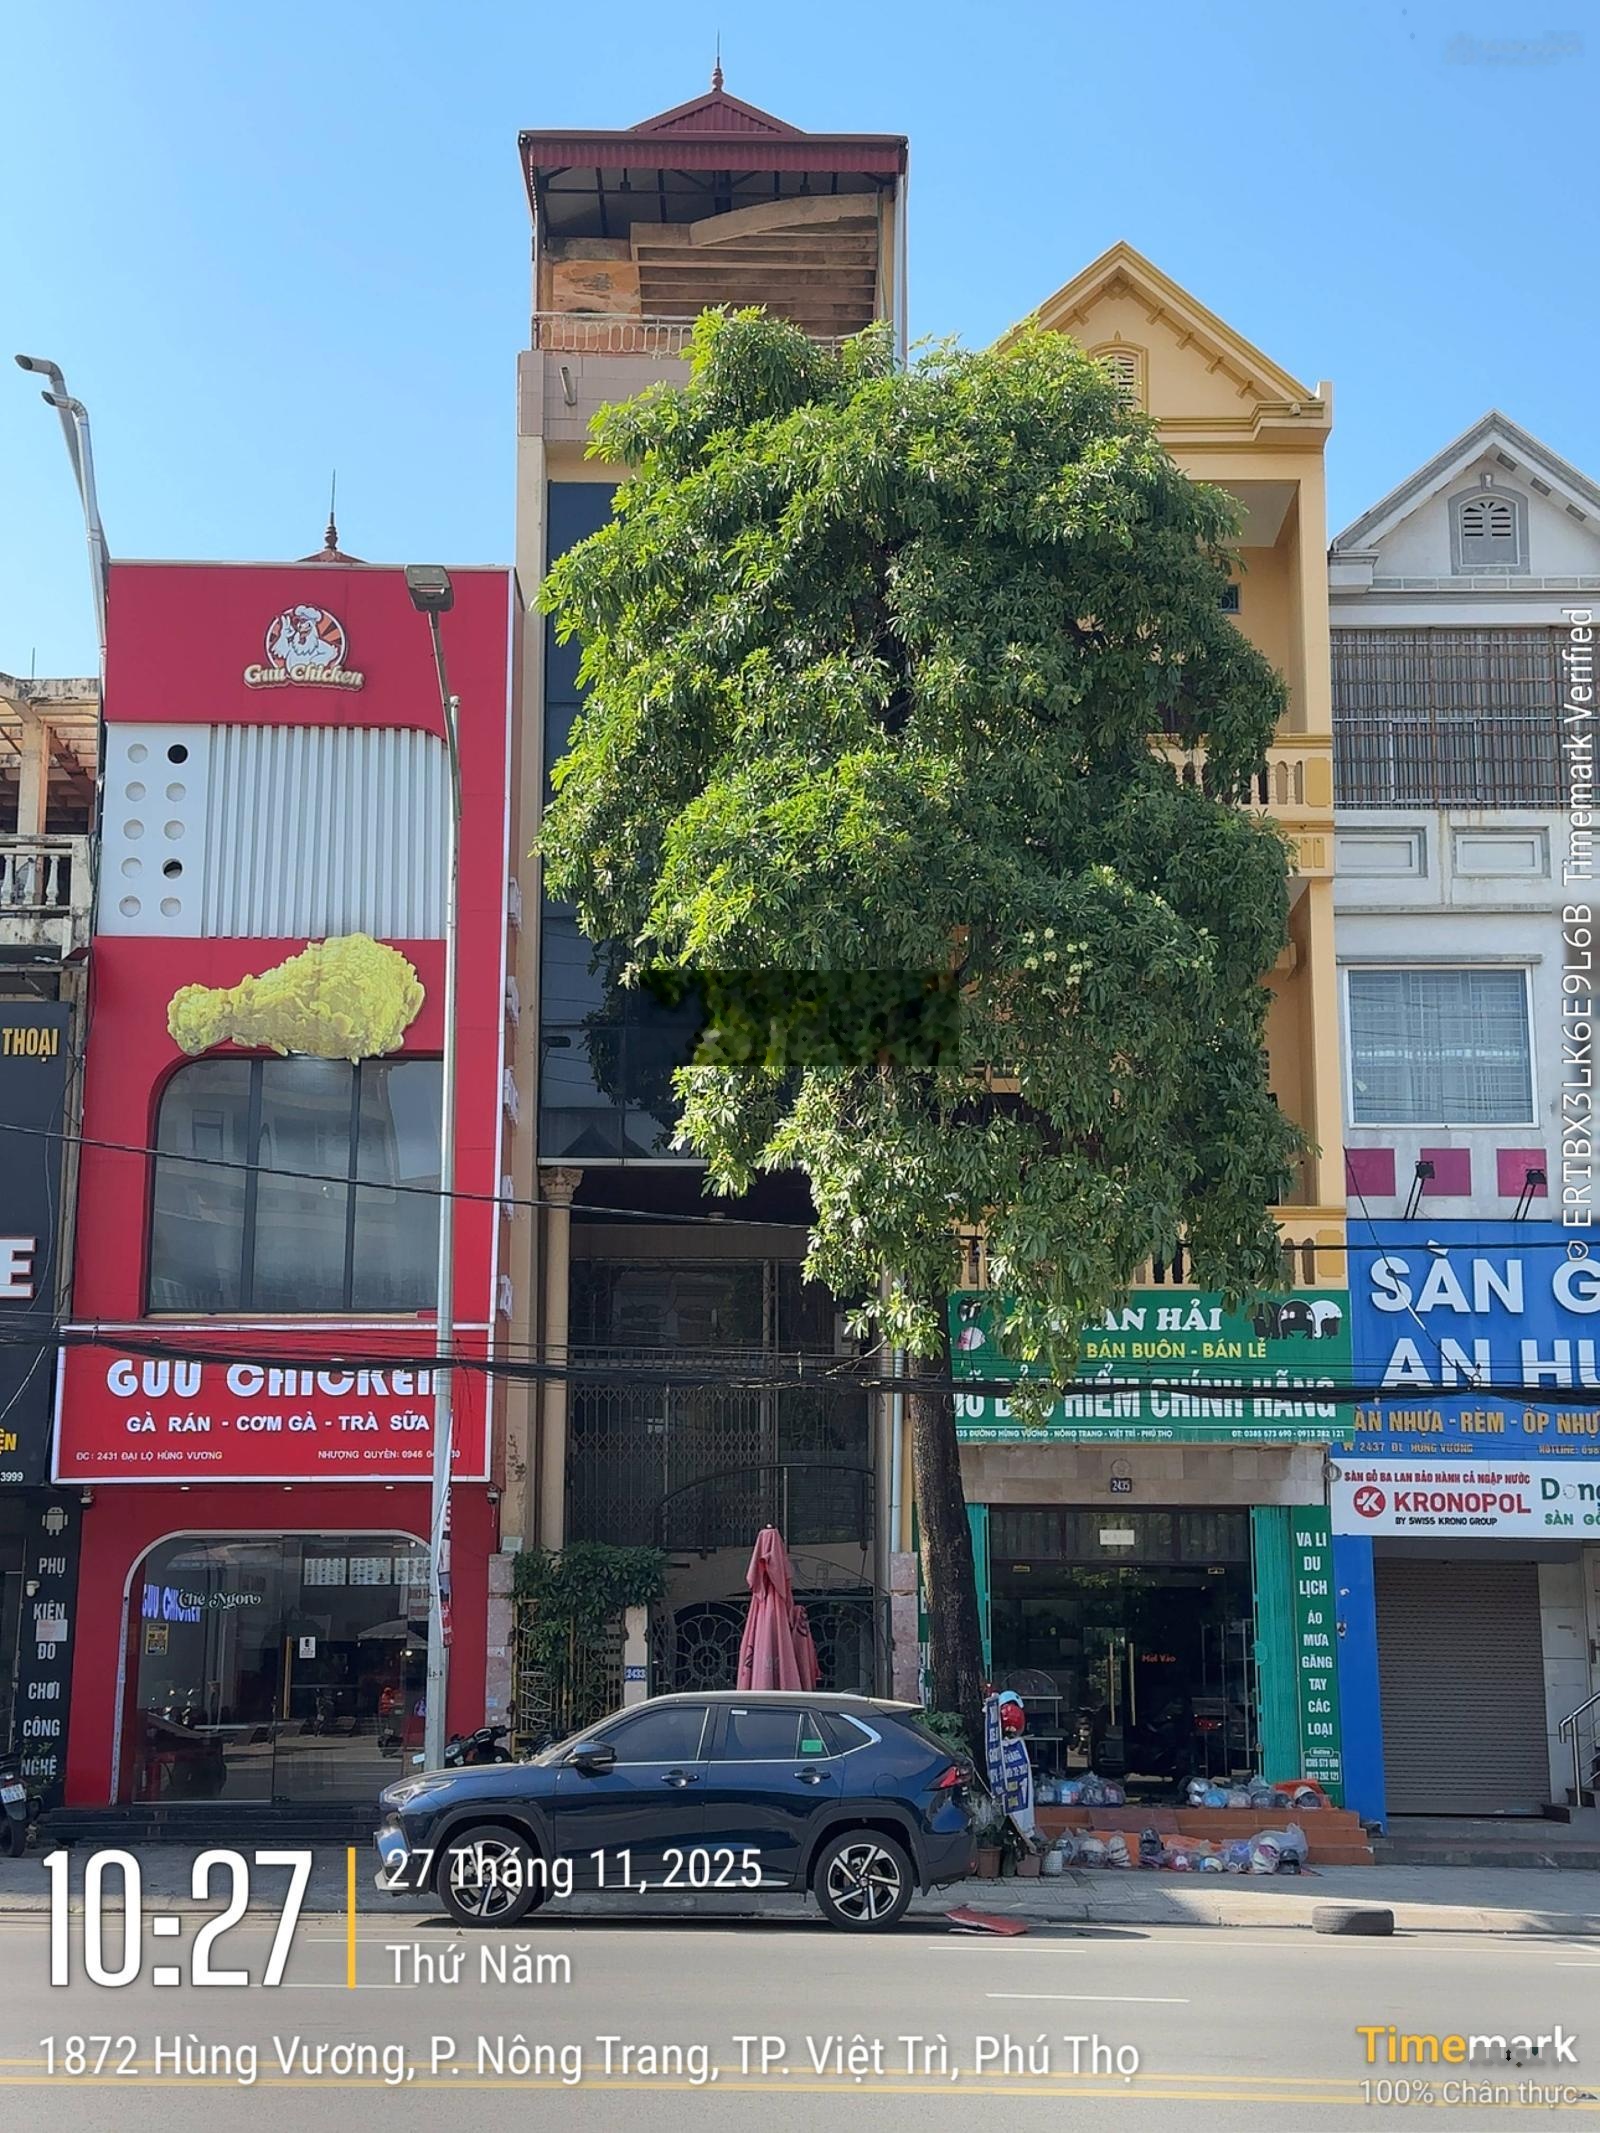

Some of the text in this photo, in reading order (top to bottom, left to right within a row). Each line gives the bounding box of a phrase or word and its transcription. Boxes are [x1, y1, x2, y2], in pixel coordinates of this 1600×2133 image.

[244, 663, 364, 689] Guu Chicken
[2, 1028, 59, 1062] THOẠI
[1370, 1239, 1524, 1313] SÀN
[1156, 1298, 1223, 1332] HẢI
[1087, 1338, 1126, 1358] BÁN
[1132, 1338, 1186, 1358] BUÔN
[1202, 1338, 1242, 1358] BÁN
[1248, 1337, 1267, 1358] LẺ
[1380, 1337, 1493, 1388] AN
[107, 1359, 201, 1398] GUU
[1150, 1368, 1244, 1418] CHÍNH
[1252, 1368, 1337, 1418] HÃNG
[126, 1411, 156, 1432] GÀ
[168, 1413, 211, 1432] RÁN
[237, 1415, 282, 1431] CƠM
[288, 1411, 317, 1431] GÀ
[339, 1411, 379, 1431] TRÀ
[390, 1409, 430, 1431] SỮA
[1355, 1406, 1382, 1432] ÀN
[1389, 1408, 1444, 1437] NHỰA
[1460, 1406, 1505, 1433] RÈM
[1522, 1403, 1550, 1433] ỐP
[1360, 1442, 1384, 1452] 2437
[97, 1452, 117, 1460] 2431
[121, 1452, 137, 1463] ĐẠI
[1345, 1470, 1364, 1482] SÀN
[1380, 1472, 1392, 1482] BA
[1394, 1472, 1412, 1482] LAN
[1111, 1481, 1130, 1491] 2435
[1394, 1491, 1531, 1514] KRONOPOL
[1395, 1517, 1498, 1526] BY SWISS KRONO GROUP
[1545, 1509, 1573, 1526] SÀN
[1296, 1532, 1327, 1547] VA LI
[38, 1557, 66, 1578] PHỤ
[1303, 1556, 1321, 1571] DU
[1299, 1580, 1328, 1598] LỊCH
[208, 1592, 262, 1610] Ngon
[1307, 1609, 1323, 1625] ÁO
[1303, 1632, 1329, 1647] MƯA
[1302, 1653, 1333, 1669] GĂNG
[28, 1682, 60, 1700] CHƠI
[1308, 1677, 1327, 1691] TAY
[1308, 1698, 1331, 1713] CÁC
[22, 1715, 61, 1737] CÔNG
[1308, 1722, 1333, 1738] LOẠI
